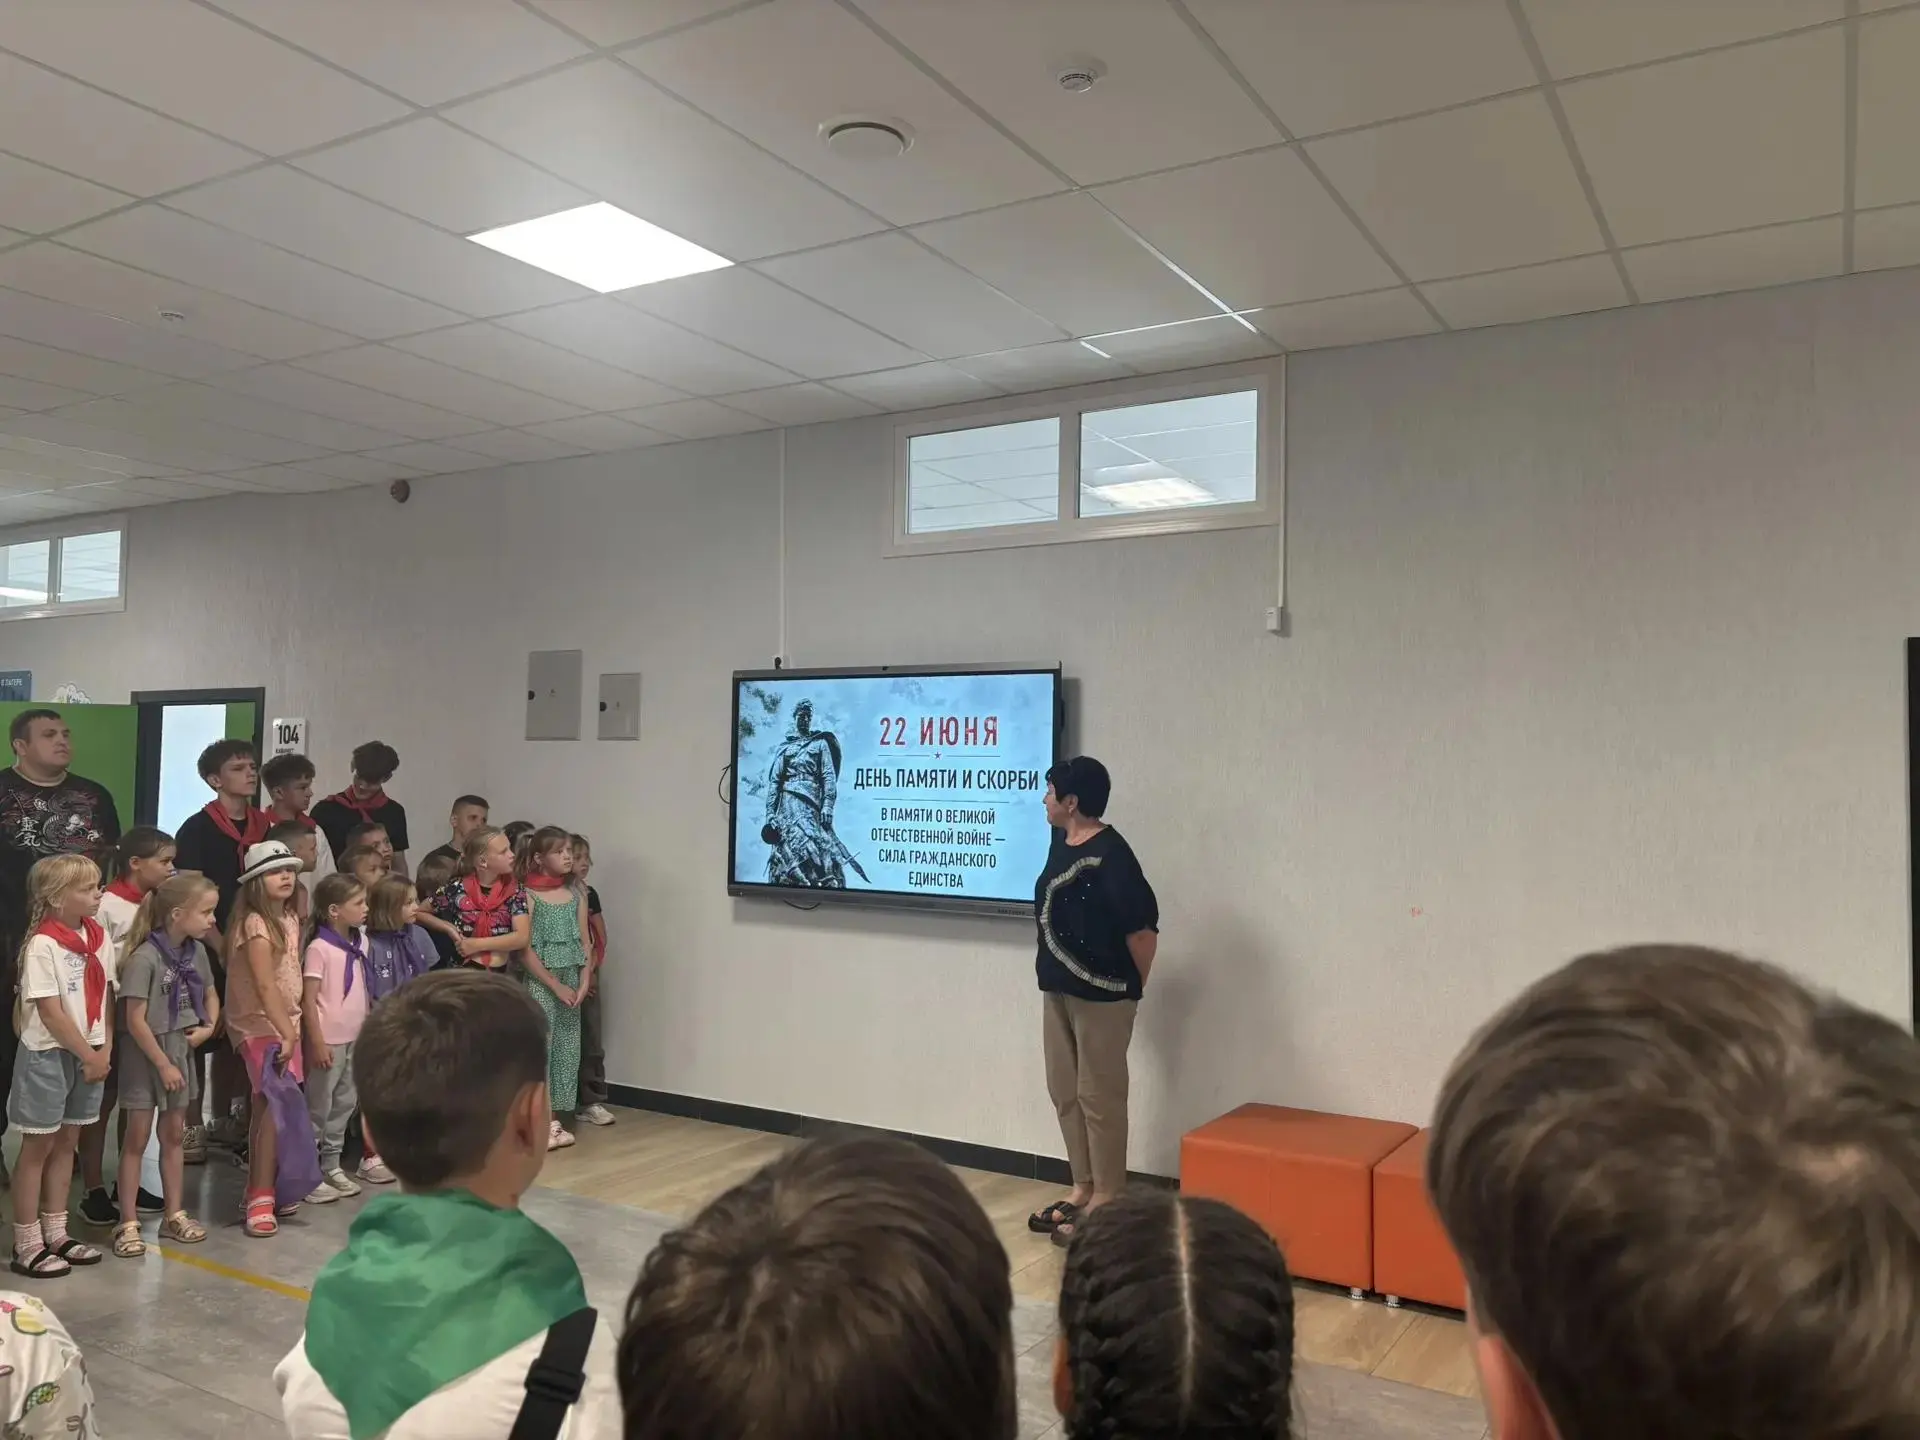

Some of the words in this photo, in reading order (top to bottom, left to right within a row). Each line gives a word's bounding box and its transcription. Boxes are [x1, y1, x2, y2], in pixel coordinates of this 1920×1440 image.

[278, 724, 299, 745] 104
[879, 717, 906, 746] 22
[920, 716, 998, 746] ИЮНЯ
[854, 768, 892, 790] ДЕНЬ
[896, 769, 957, 789] ПАМЯТИ
[962, 769, 972, 790] И
[977, 770, 1039, 791] СКОРБИ
[881, 807, 888, 821] В
[890, 807, 933, 822] ПАМЯТИ
[936, 809, 943, 823] О
[945, 808, 995, 825] ВЕЛИКОЙ
[871, 828, 954, 845] ОТЕЧЕСТВЕННОЙ
[957, 829, 992, 847] ВОЙНЕ
[878, 848, 906, 864] СИЛА
[909, 850, 997, 869] ГРАЖДАНСКОГО
[908, 871, 964, 888] ЕДИНСТВА
